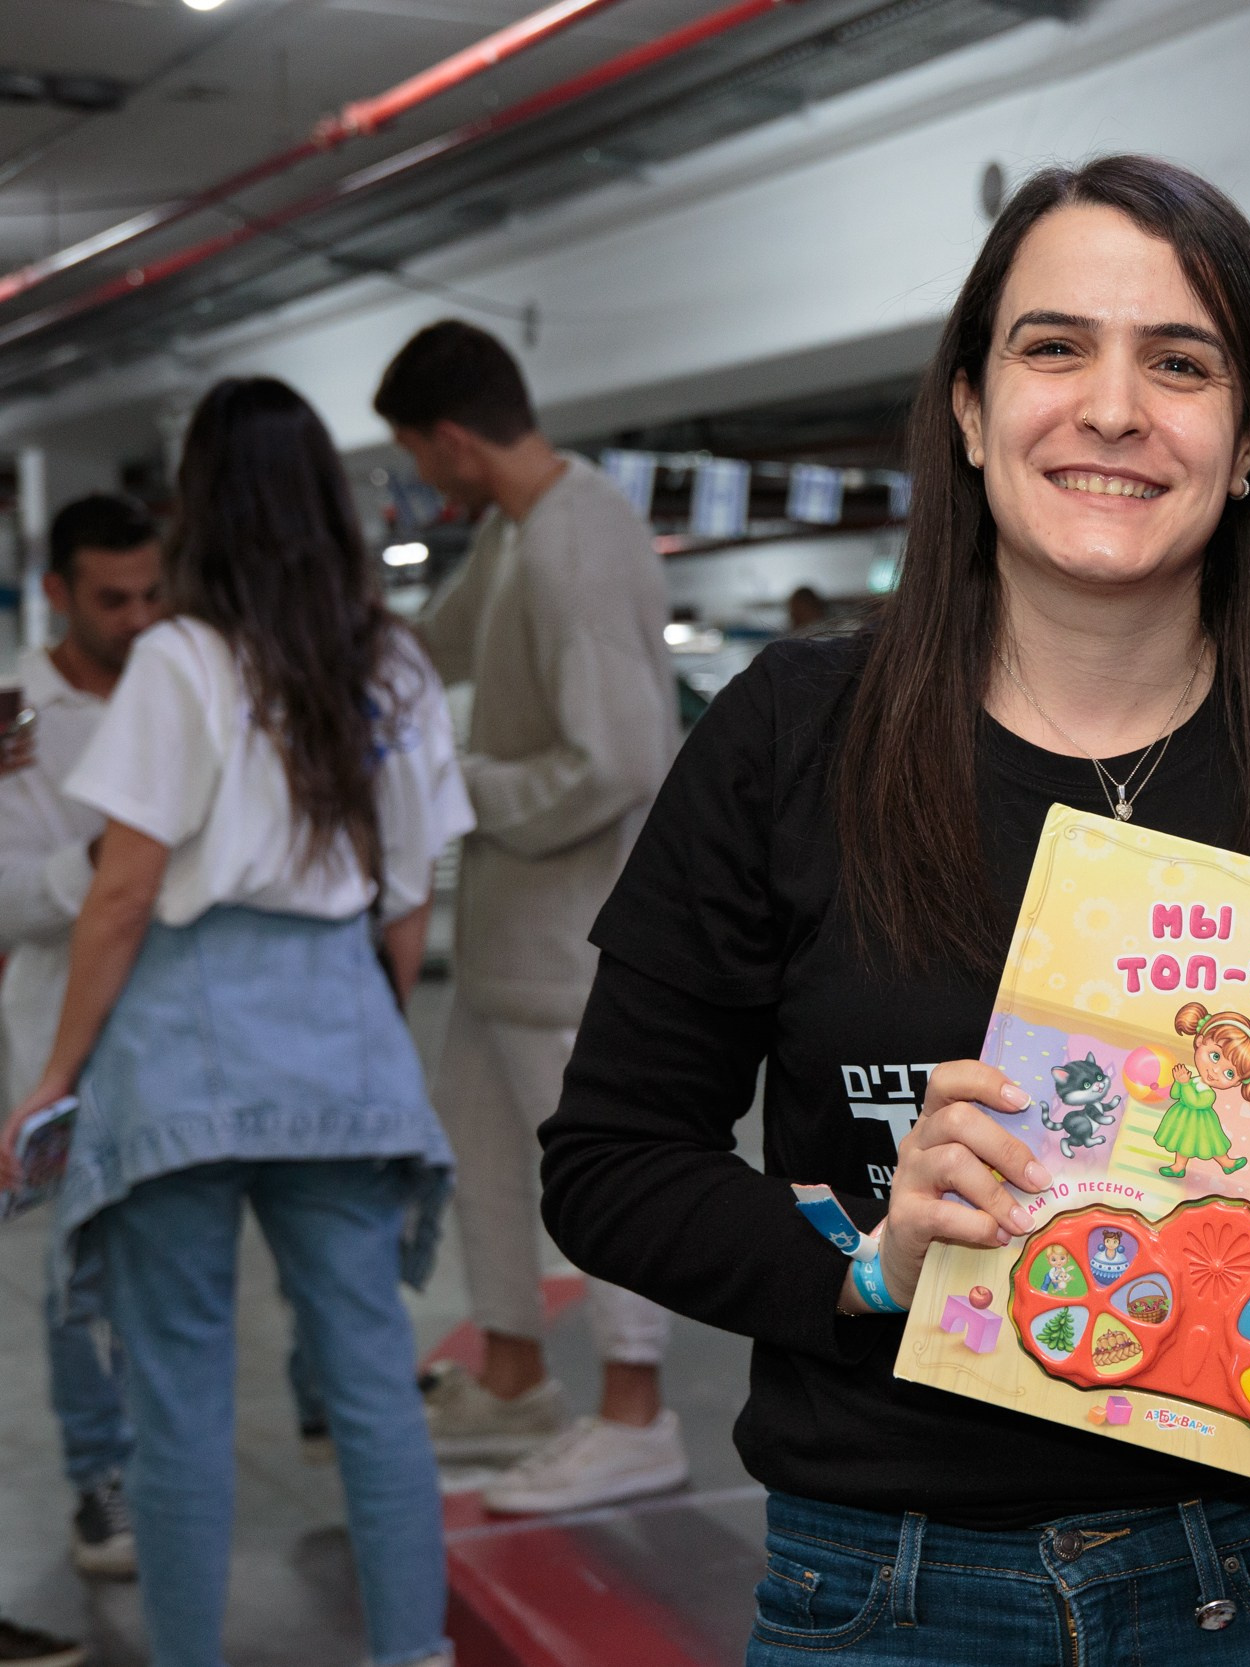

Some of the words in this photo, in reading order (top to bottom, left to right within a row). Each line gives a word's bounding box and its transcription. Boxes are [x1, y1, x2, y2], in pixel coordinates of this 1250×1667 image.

[1152, 903, 1233, 940] МЫ
[1028, 1196, 1047, 1215] АЙ
[1050, 1183, 1069, 1200] 10
[1078, 1181, 1145, 1202] ПЕСЕНОК
